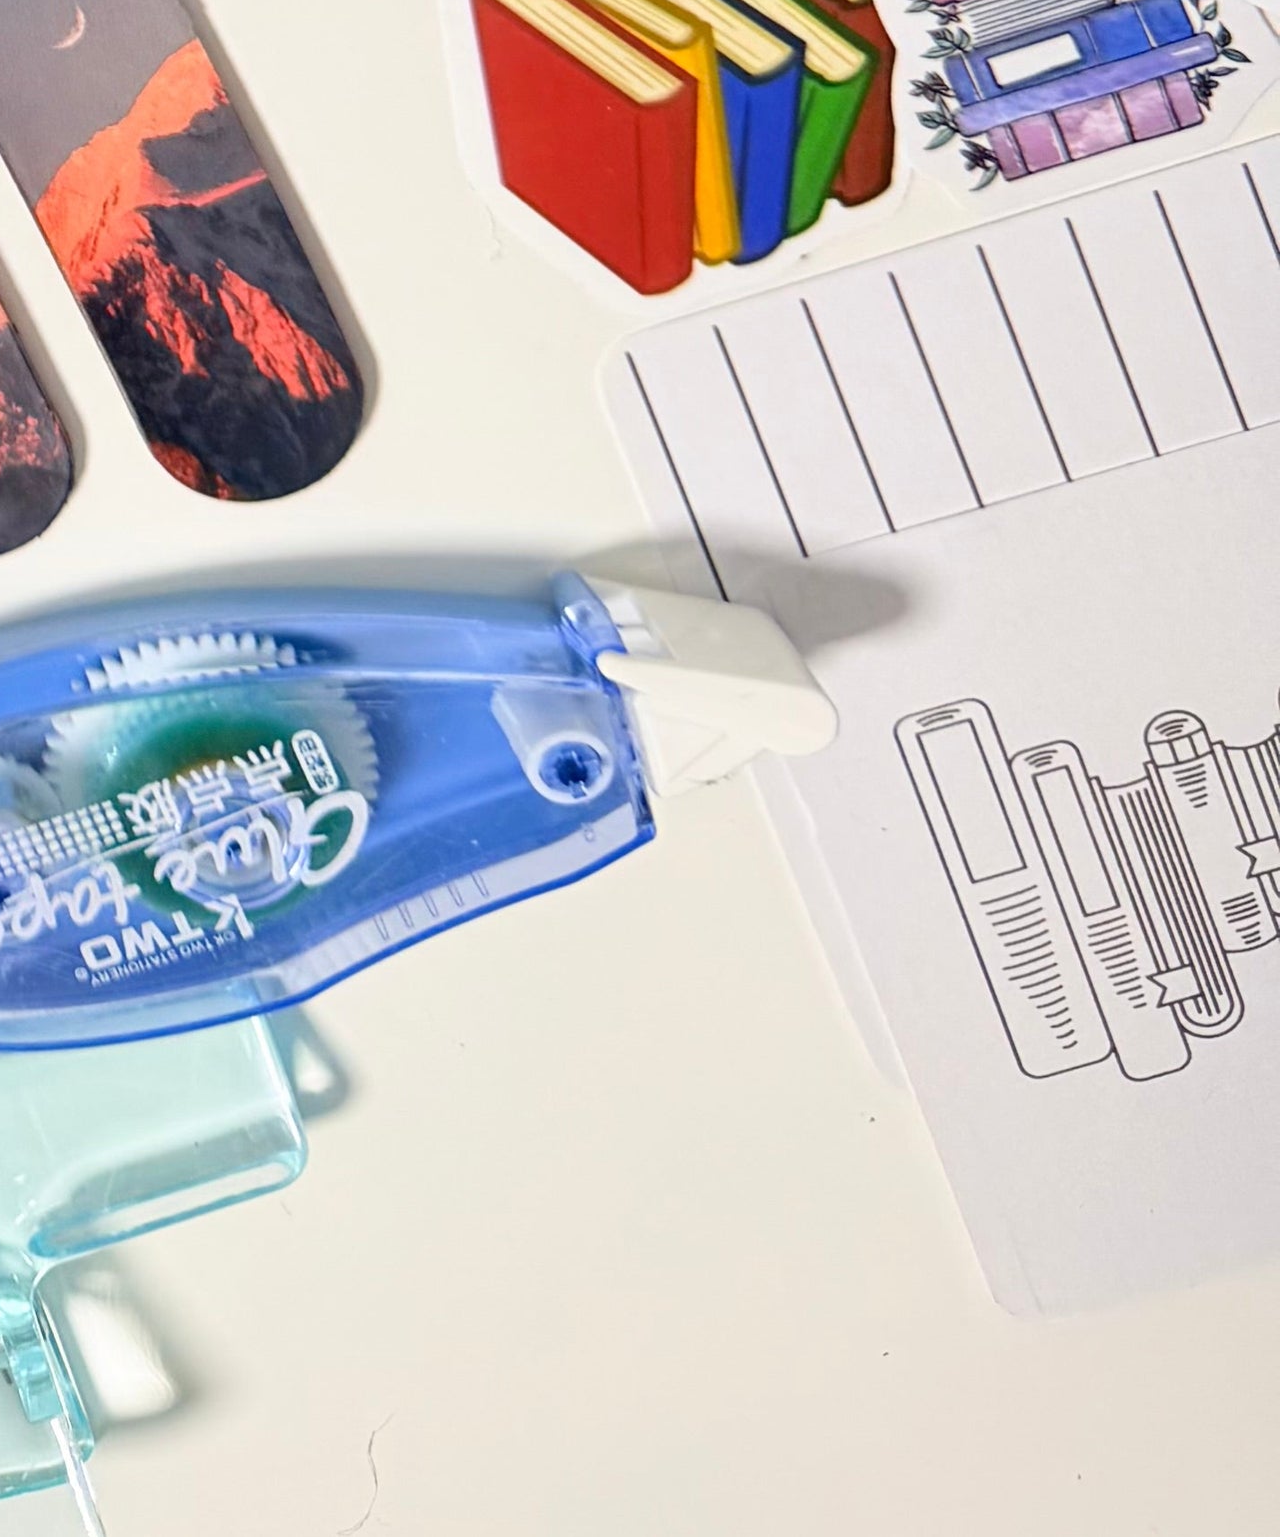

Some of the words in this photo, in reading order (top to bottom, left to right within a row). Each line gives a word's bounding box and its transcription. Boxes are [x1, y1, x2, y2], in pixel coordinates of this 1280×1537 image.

[116, 739, 293, 838] 点点胶
[153, 789, 370, 893] Glue
